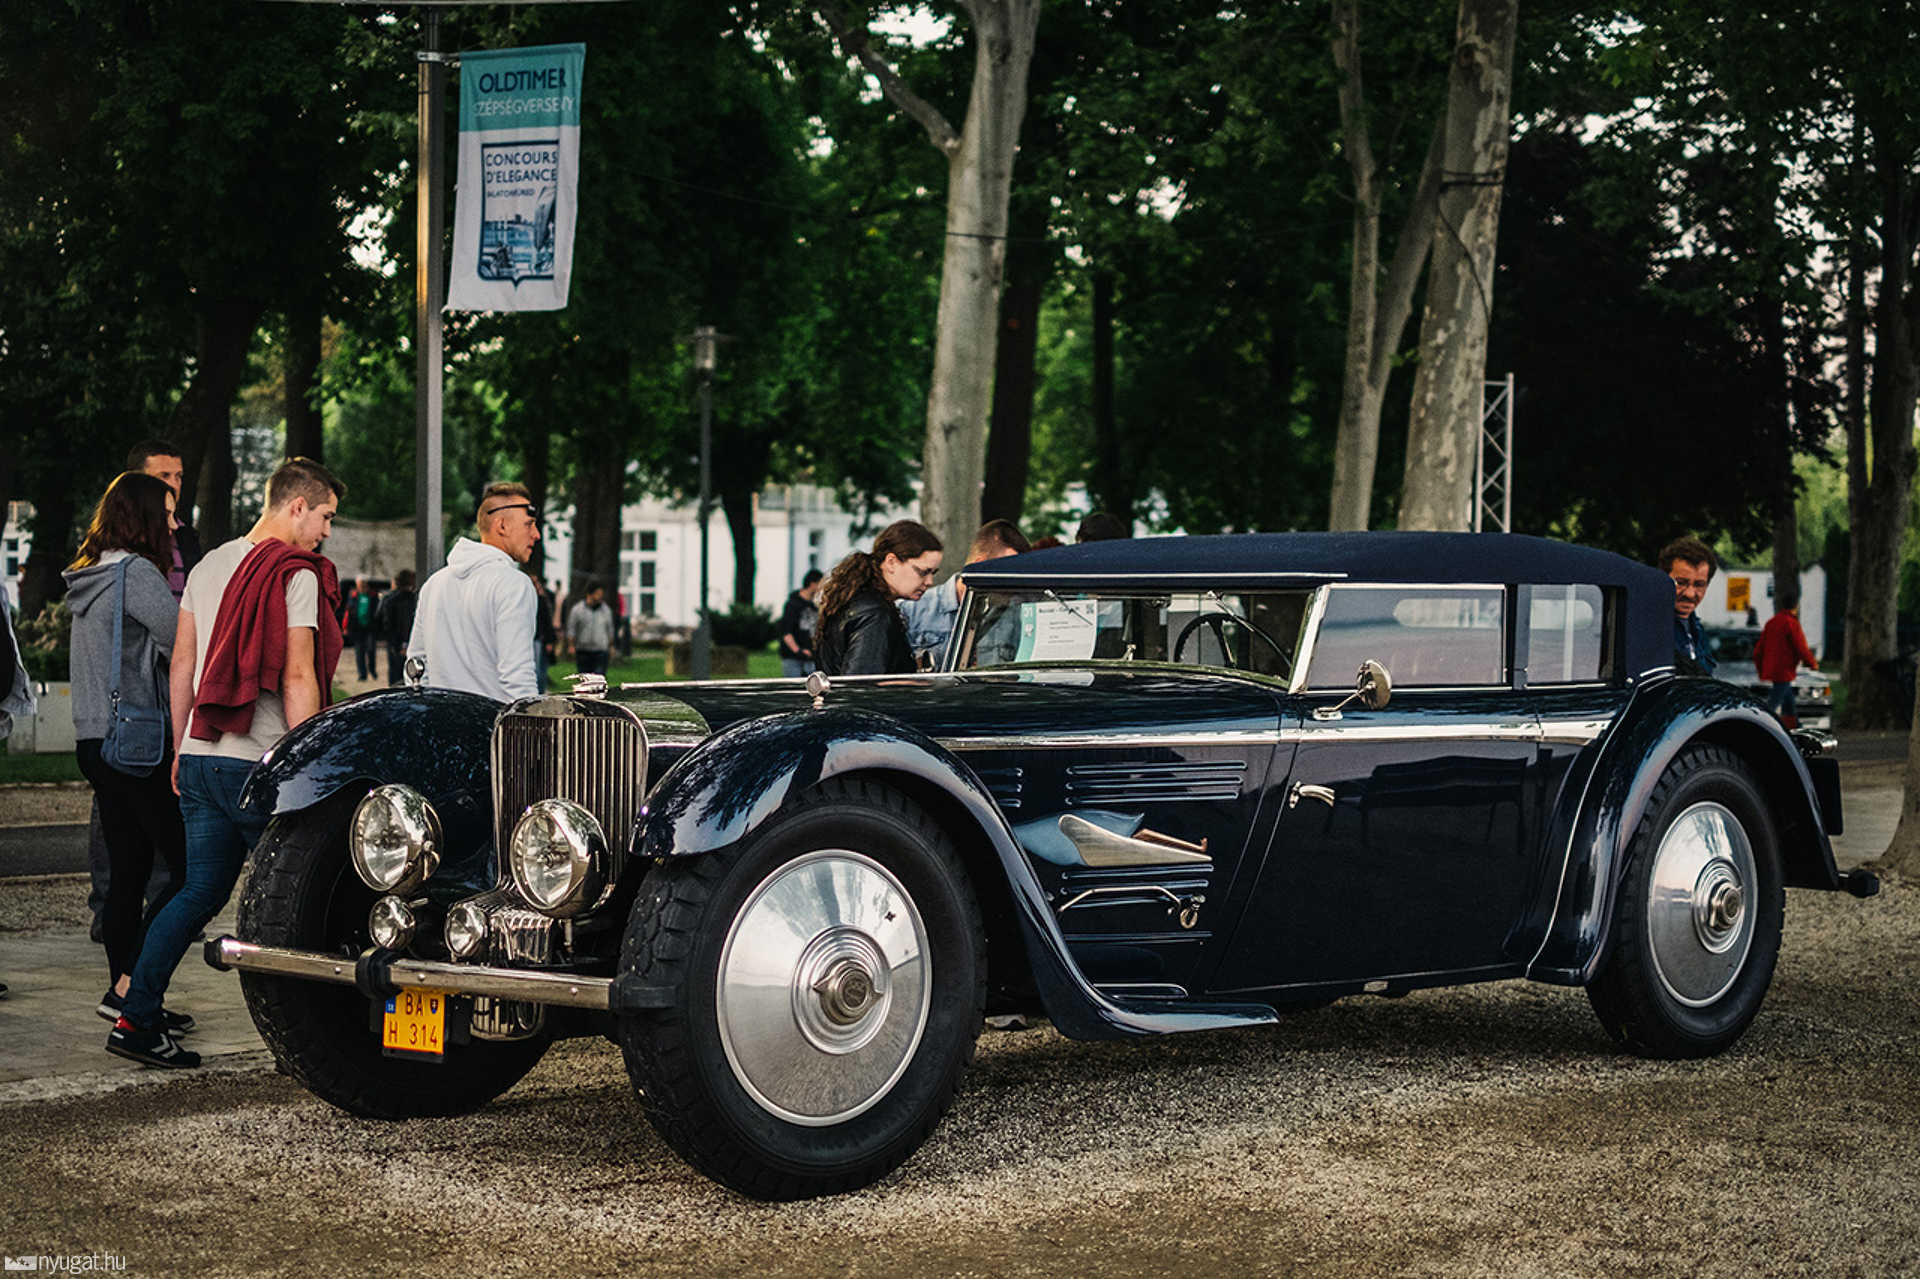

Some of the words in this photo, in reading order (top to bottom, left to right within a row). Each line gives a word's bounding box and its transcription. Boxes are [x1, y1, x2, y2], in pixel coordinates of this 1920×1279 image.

[479, 68, 567, 94] OLDTIMER
[486, 151, 559, 167] CONCOURS
[486, 168, 558, 184] D'ELEGANCE
[406, 992, 423, 1016] BA
[389, 1020, 398, 1044] H
[409, 1023, 438, 1049] 314
